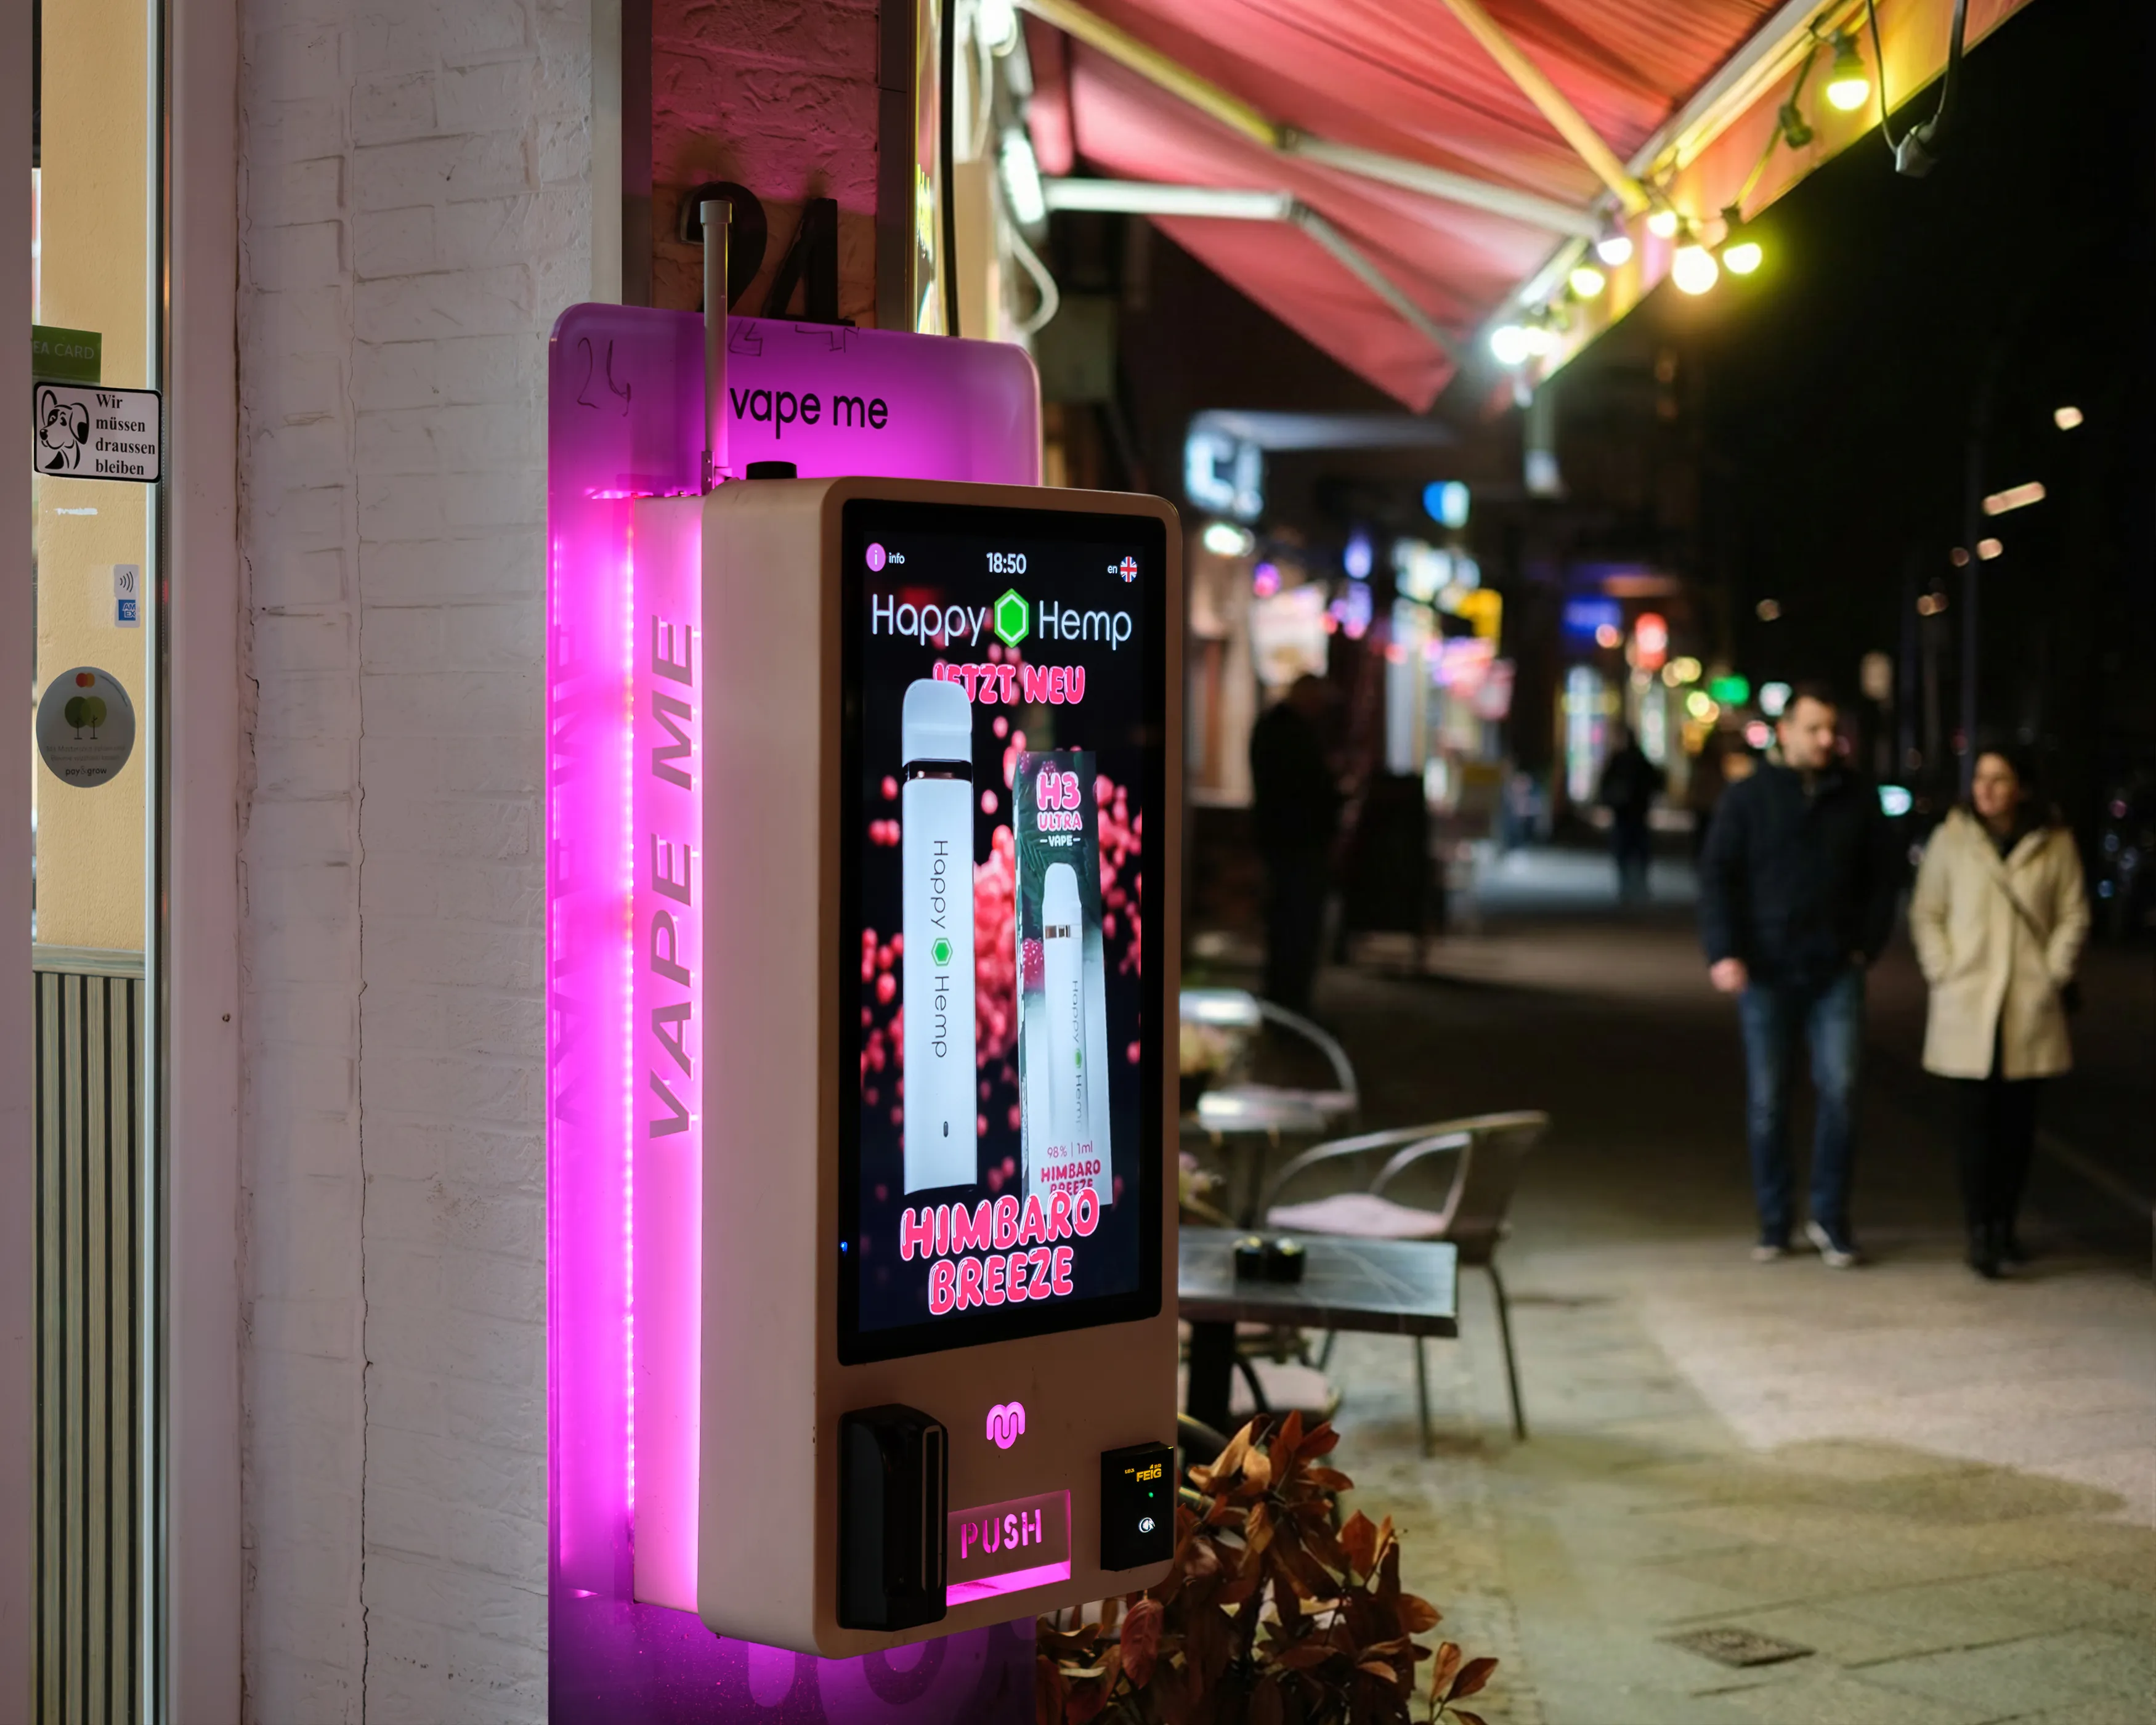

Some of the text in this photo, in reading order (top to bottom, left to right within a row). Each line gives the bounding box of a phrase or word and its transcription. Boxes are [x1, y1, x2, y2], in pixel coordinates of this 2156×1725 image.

[54, 343, 94, 360] CARD
[95, 393, 123, 409] Wir
[95, 416, 146, 432] müssen
[729, 388, 888, 440] vape me
[95, 437, 156, 455] draussen
[95, 459, 145, 476] bleiben
[888, 552, 906, 565] info
[986, 552, 1027, 575] 18:50
[1107, 564, 1118, 575] en
[872, 593, 1132, 651] Happy Hemp
[1024, 665, 1085, 705] NEU
[1036, 771, 1081, 811] H3
[1037, 811, 1083, 832] ULTRA
[649, 614, 694, 1140] VAPE ME
[930, 840, 950, 1058] Happy Hemp
[1071, 980, 1079, 1043] Happy
[1047, 1145, 1068, 1158] 98%
[1077, 1140, 1093, 1155] 1ml
[1040, 1159, 1101, 1183] HIMBARO
[900, 1187, 1100, 1262] HIMBARO
[928, 1246, 1074, 1316] BREEZE
[1136, 1467, 1162, 1482] FEIG
[961, 1509, 1043, 1559] PUSH
